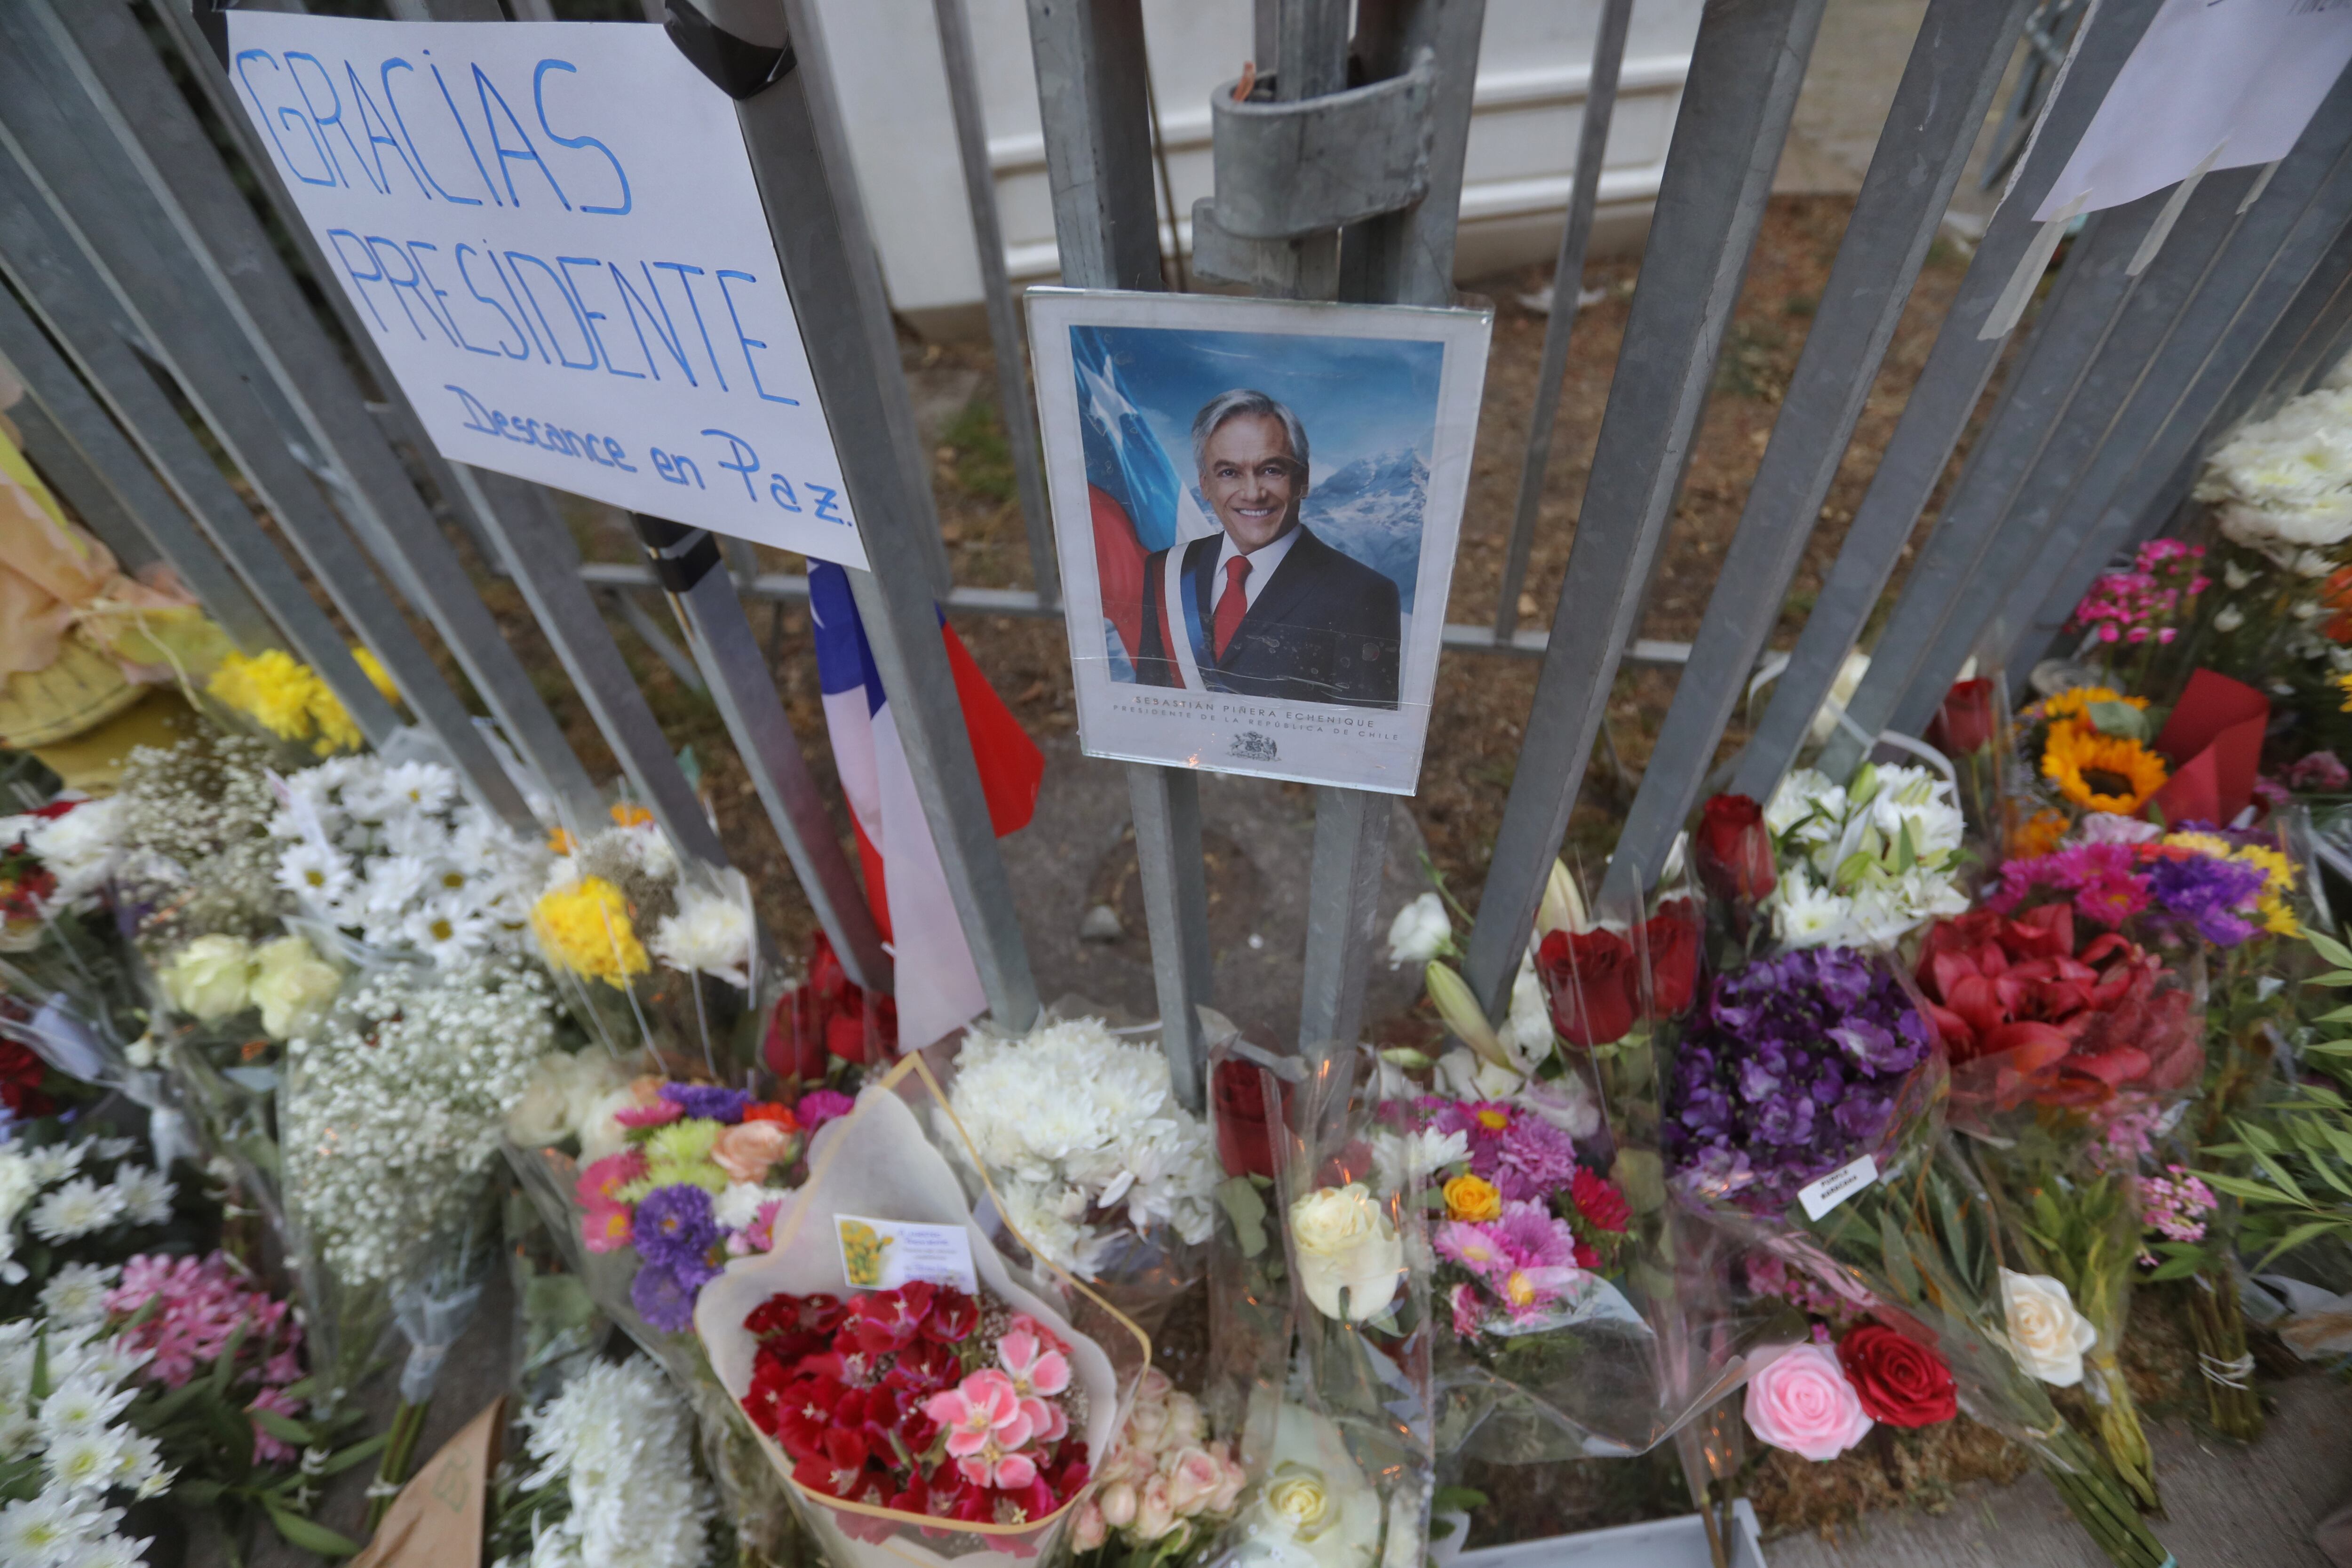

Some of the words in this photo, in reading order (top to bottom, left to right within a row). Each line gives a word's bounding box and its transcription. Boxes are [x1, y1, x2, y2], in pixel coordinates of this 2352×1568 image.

[445, 384, 638, 472] Descance
[650, 447, 706, 490] en
[700, 428, 852, 527] Paz.
[1113, 704, 1192, 718] PRESIDENTE
[1248, 719, 1323, 732] REPÚBLICA
[1358, 731, 1398, 740] CHILE
[1136, 696, 1214, 711] SEBASTIÁN
[1223, 705, 1276, 717] PIÑERA
[1286, 712, 1374, 728] ECHENIQUE
